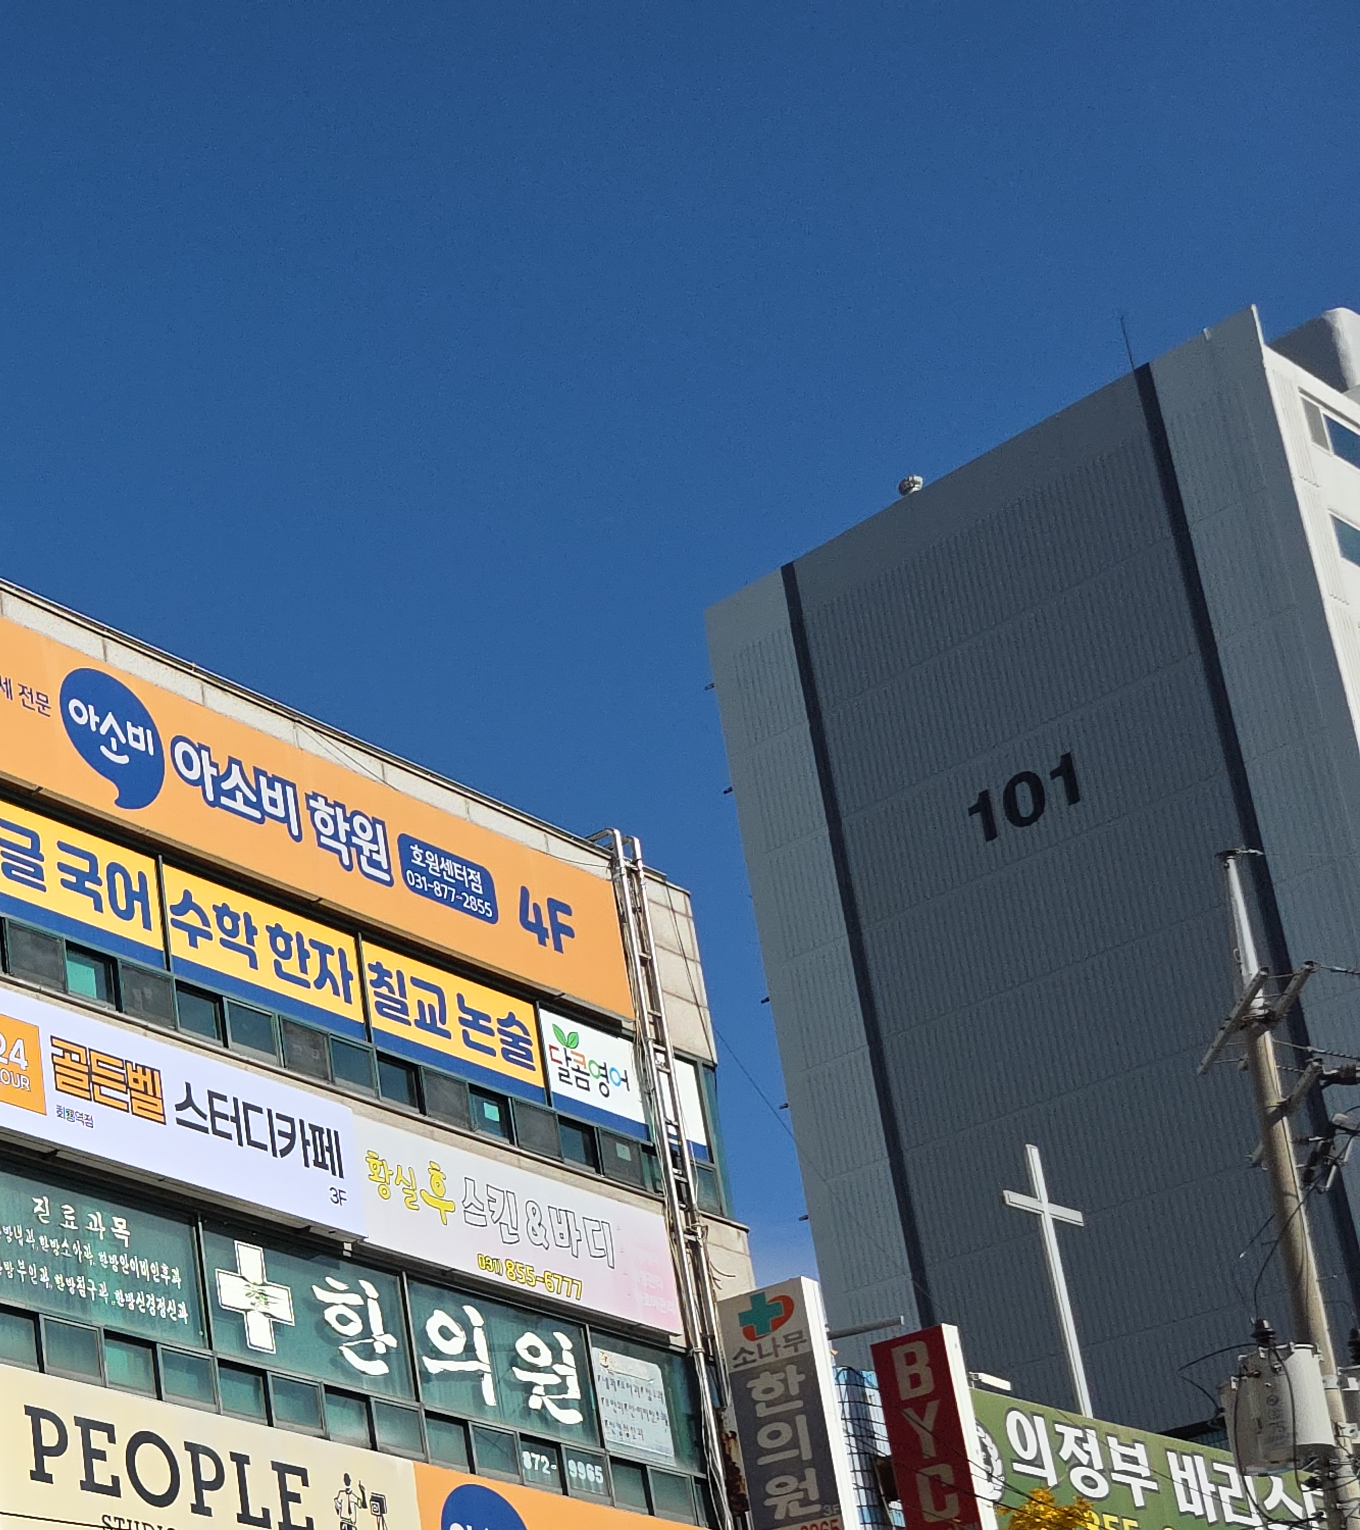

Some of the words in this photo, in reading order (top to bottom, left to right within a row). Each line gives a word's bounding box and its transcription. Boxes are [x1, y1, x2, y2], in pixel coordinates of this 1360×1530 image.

[17, 682, 52, 717] 전문
[68, 698, 154, 764] 아소비
[171, 737, 301, 840] 아소비
[307, 792, 392, 885] 학원
[967, 752, 1081, 842] 101
[57, 839, 152, 931] 국어
[406, 867, 494, 918] 031-877-2855
[409, 843, 484, 895] 호원센터점
[169, 889, 260, 971] 수학
[267, 923, 354, 1004] 한자
[519, 885, 575, 954] 4F
[368, 960, 453, 1040] 칠교
[457, 992, 537, 1073] 논술
[50, 1035, 167, 1125] 골든벨
[175, 1081, 345, 1179] 스터디카페
[549, 1045, 630, 1098] 달콤영어
[32, 1196, 132, 1248] 진료과목
[328, 1187, 347, 1206] 3F
[462, 1176, 616, 1269] 스킨&바디
[505, 1259, 583, 1300] 855-6777
[311, 1275, 584, 1425] 한의원
[731, 1330, 808, 1368] 소나무
[746, 1363, 822, 1520] 한의원
[890, 1340, 961, 1524] BYC
[1005, 1409, 1159, 1509] 의정부
